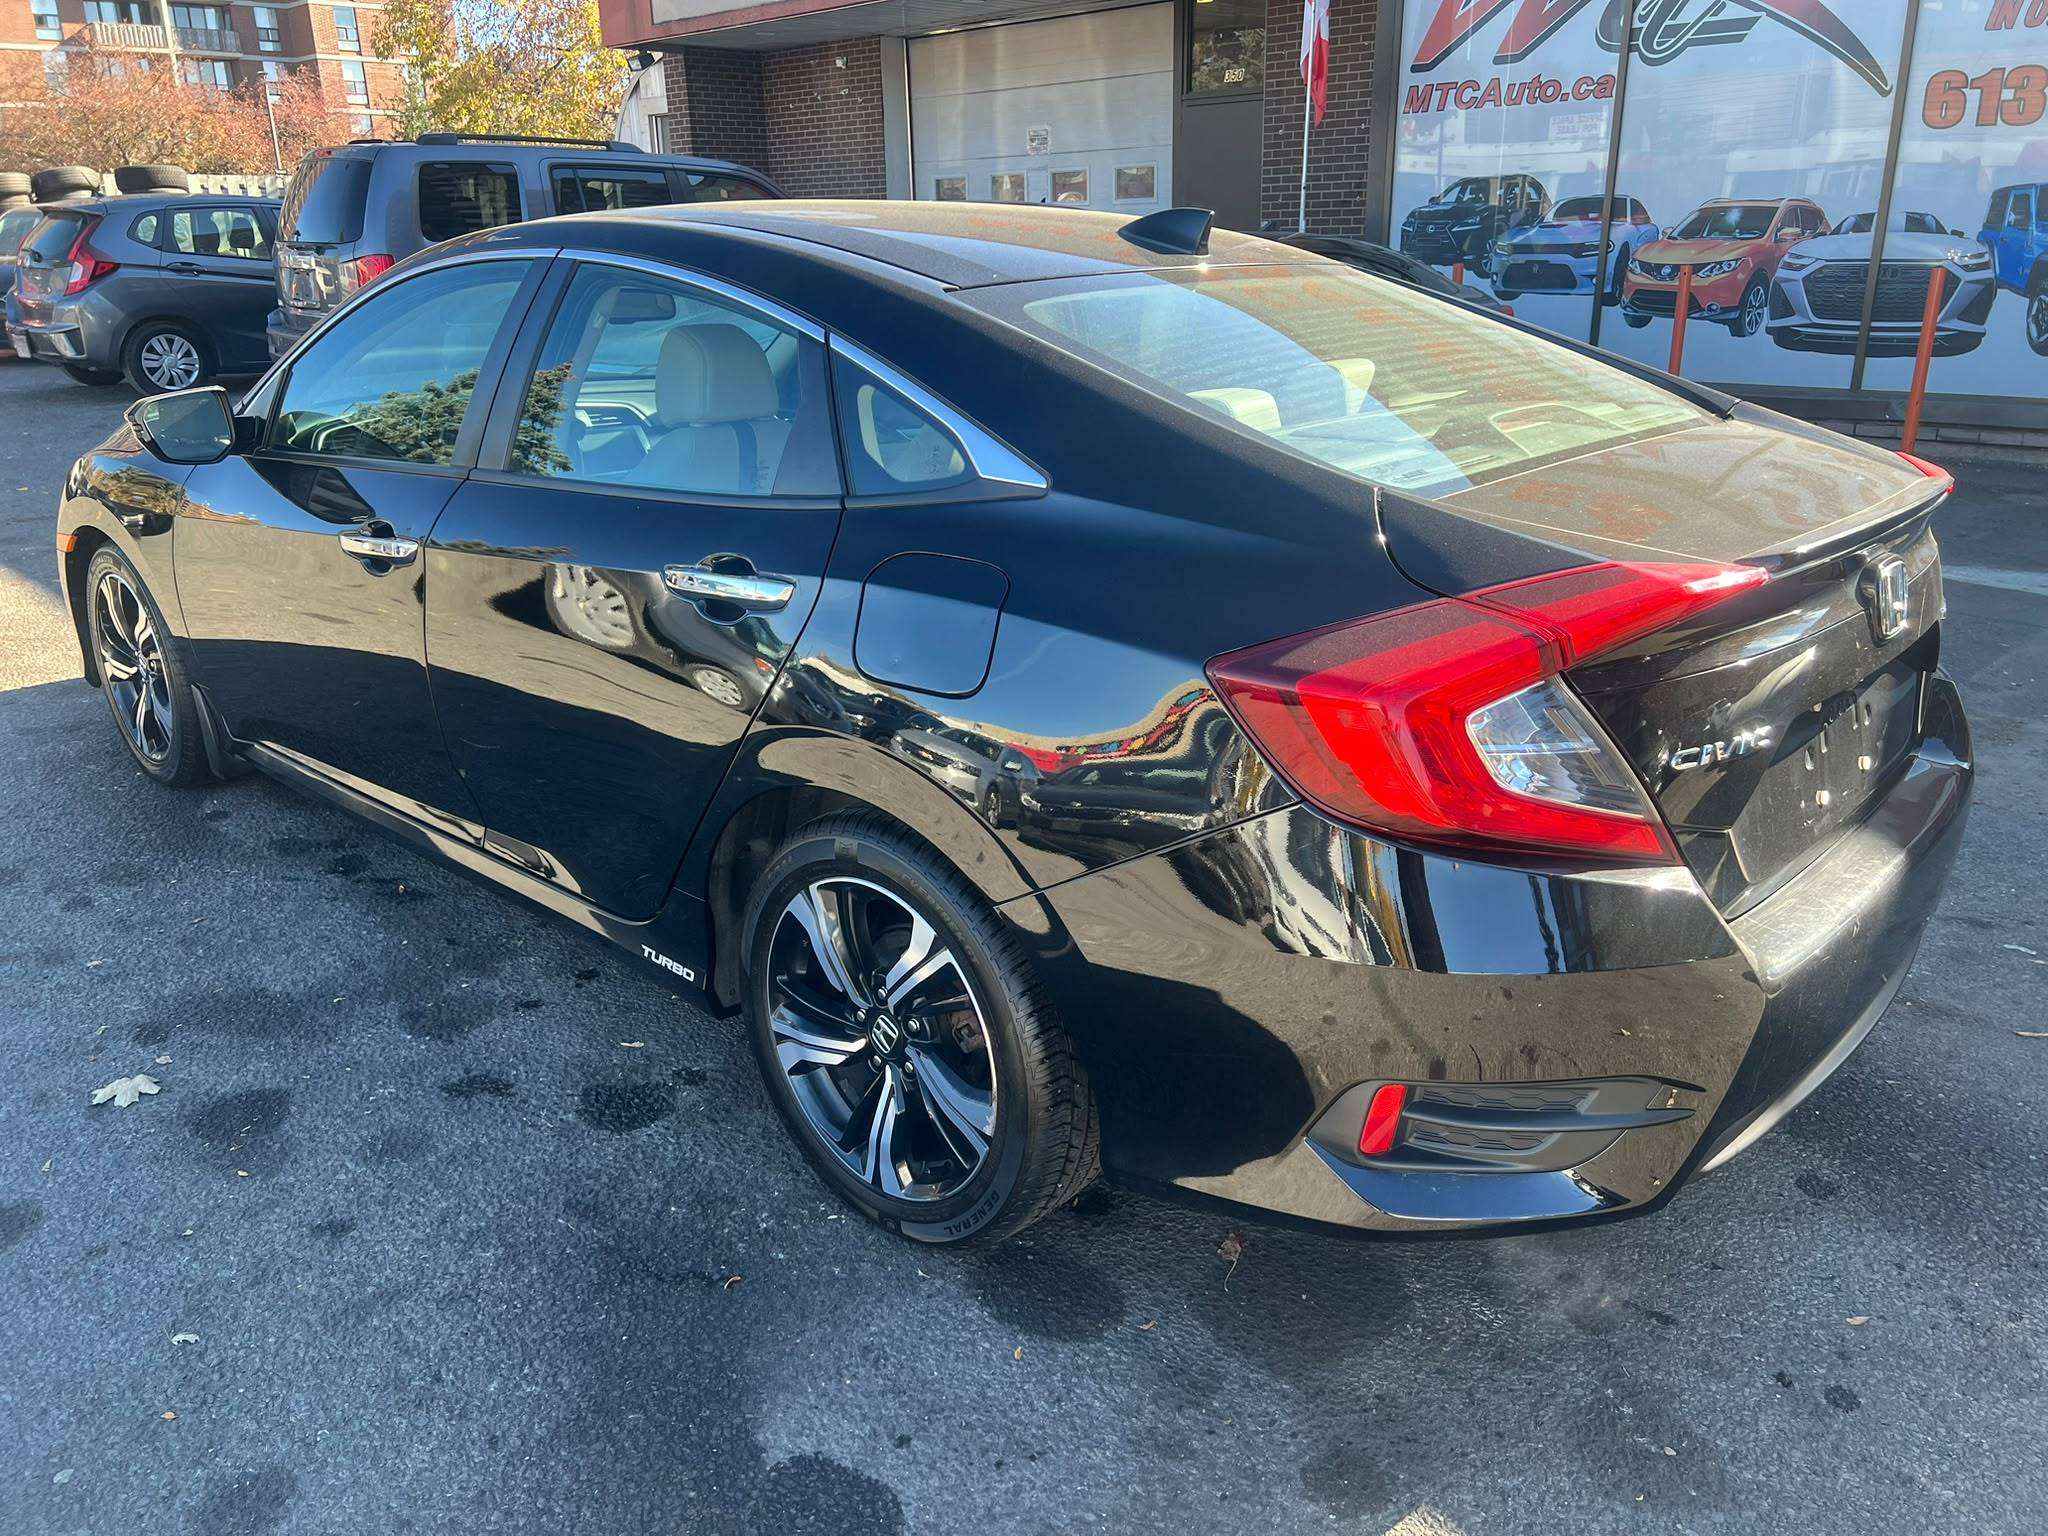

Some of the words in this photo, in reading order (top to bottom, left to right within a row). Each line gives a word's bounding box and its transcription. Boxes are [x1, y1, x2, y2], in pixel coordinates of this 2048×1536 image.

[1402, 73, 1616, 114] MTCAuto.ca
[1922, 64, 2048, 129] 613
[641, 944, 695, 982] TURBO
[943, 1190, 1000, 1235] GENERAL
